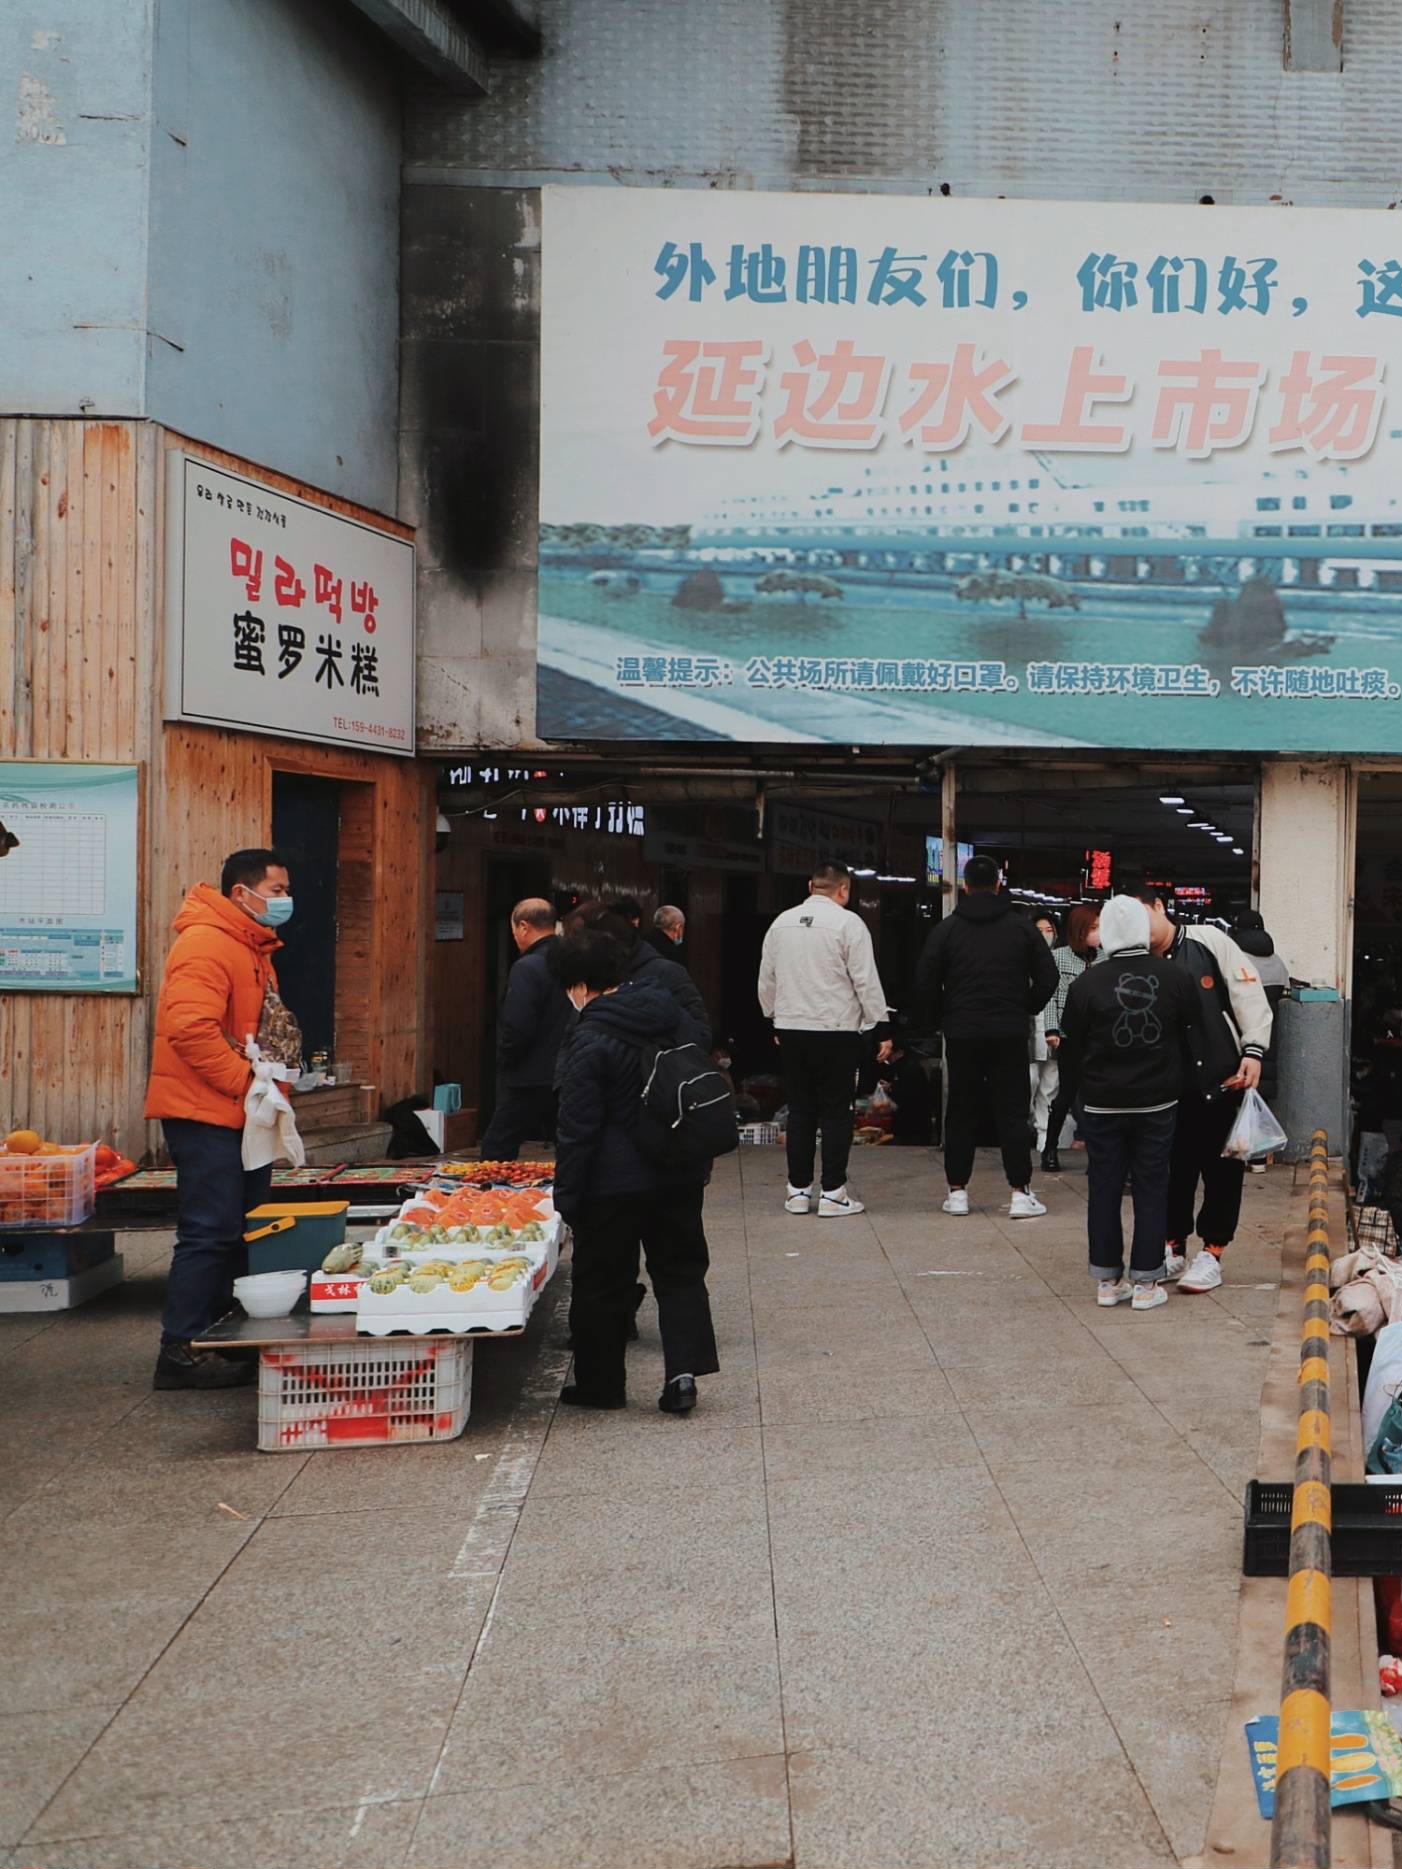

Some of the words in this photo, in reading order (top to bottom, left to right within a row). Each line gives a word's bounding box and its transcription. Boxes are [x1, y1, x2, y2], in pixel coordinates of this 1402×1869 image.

[647, 337, 1383, 457] 延边水上市场
[233, 610, 380, 698] 蜜罗米糕
